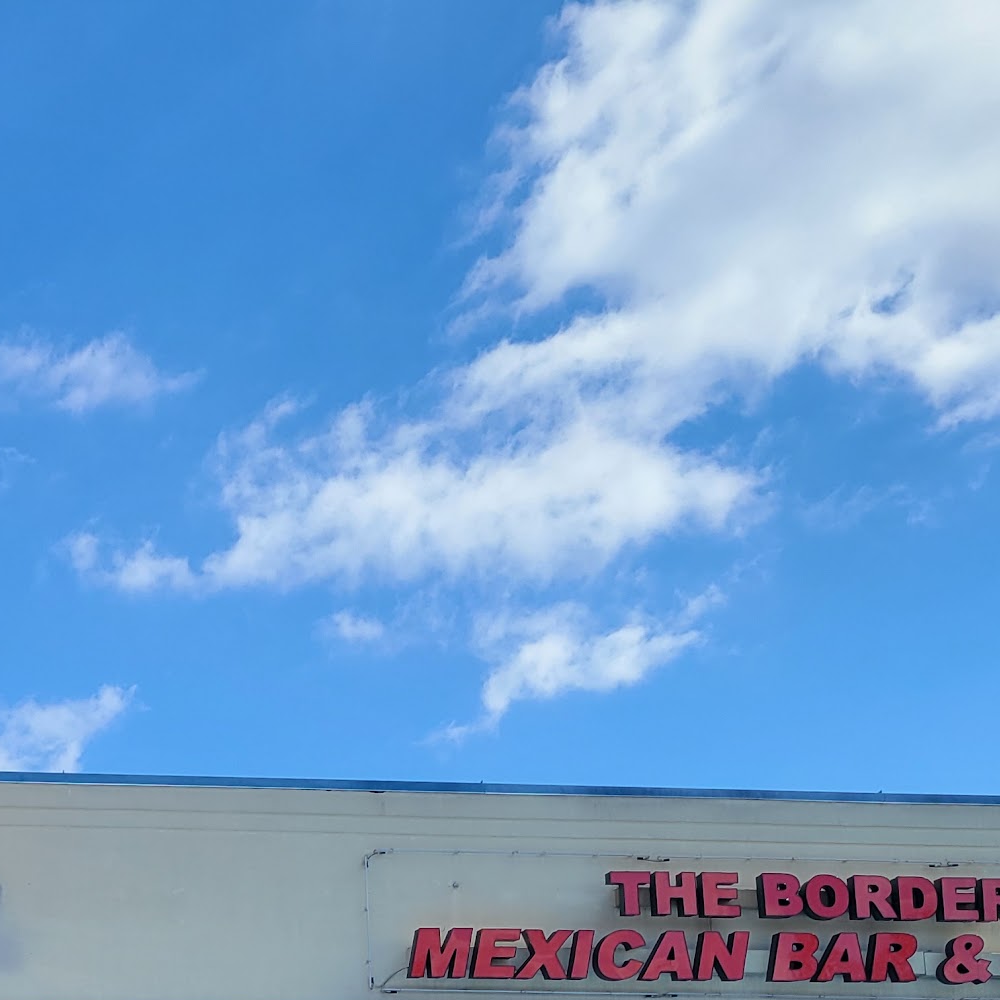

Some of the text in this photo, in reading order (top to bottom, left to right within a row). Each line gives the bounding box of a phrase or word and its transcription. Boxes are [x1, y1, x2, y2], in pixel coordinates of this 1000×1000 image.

[605, 871, 742, 918] THE
[407, 927, 993, 985] MEXICAN BAR &
